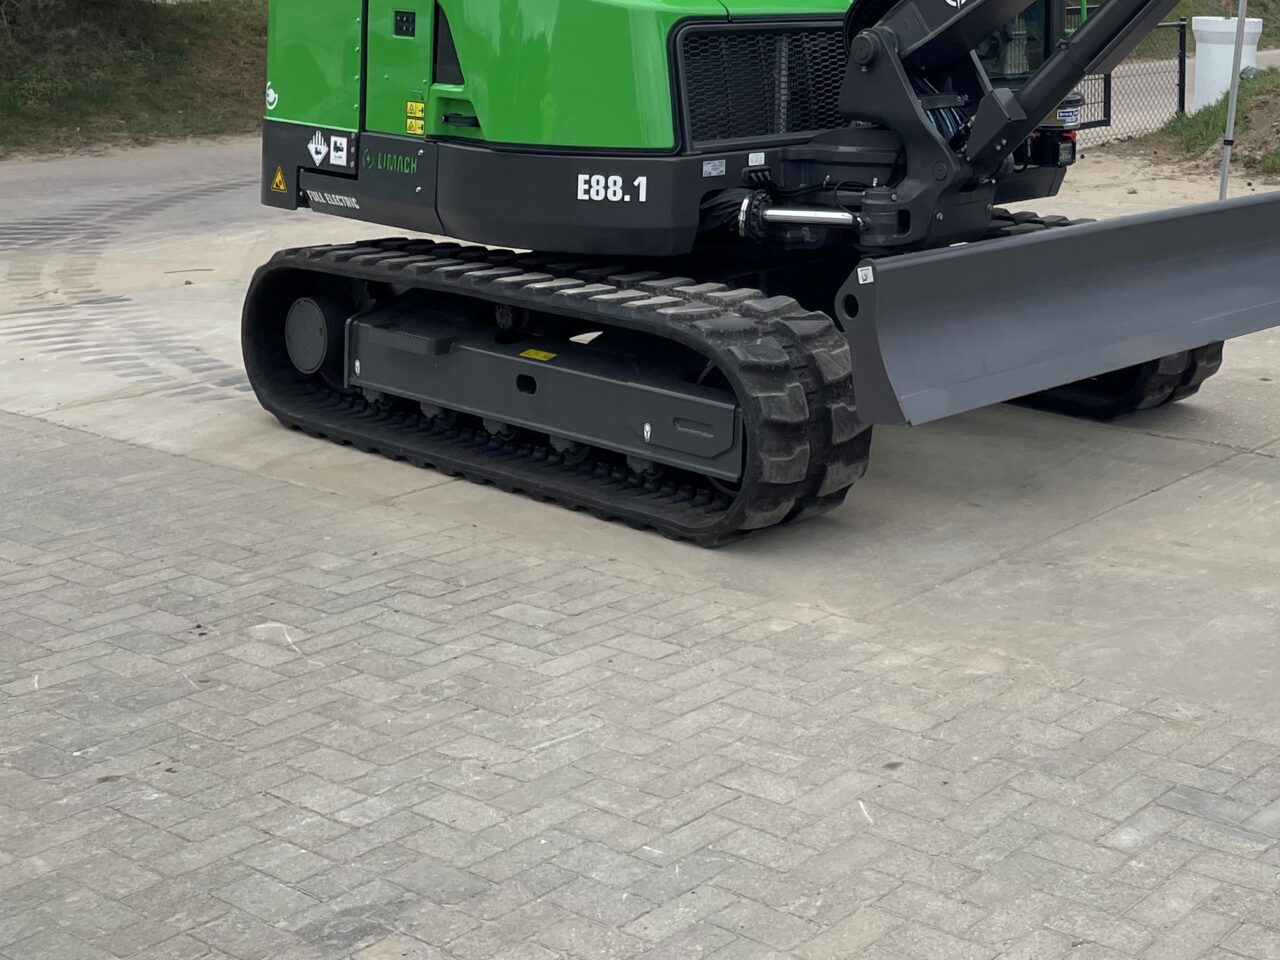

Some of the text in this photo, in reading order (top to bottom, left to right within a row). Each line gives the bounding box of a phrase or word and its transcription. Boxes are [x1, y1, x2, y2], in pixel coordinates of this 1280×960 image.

[377, 152, 418, 174] LIMACH
[577, 173, 647, 202] E88.1
[306, 189, 361, 210] FULL ELECTRIC
